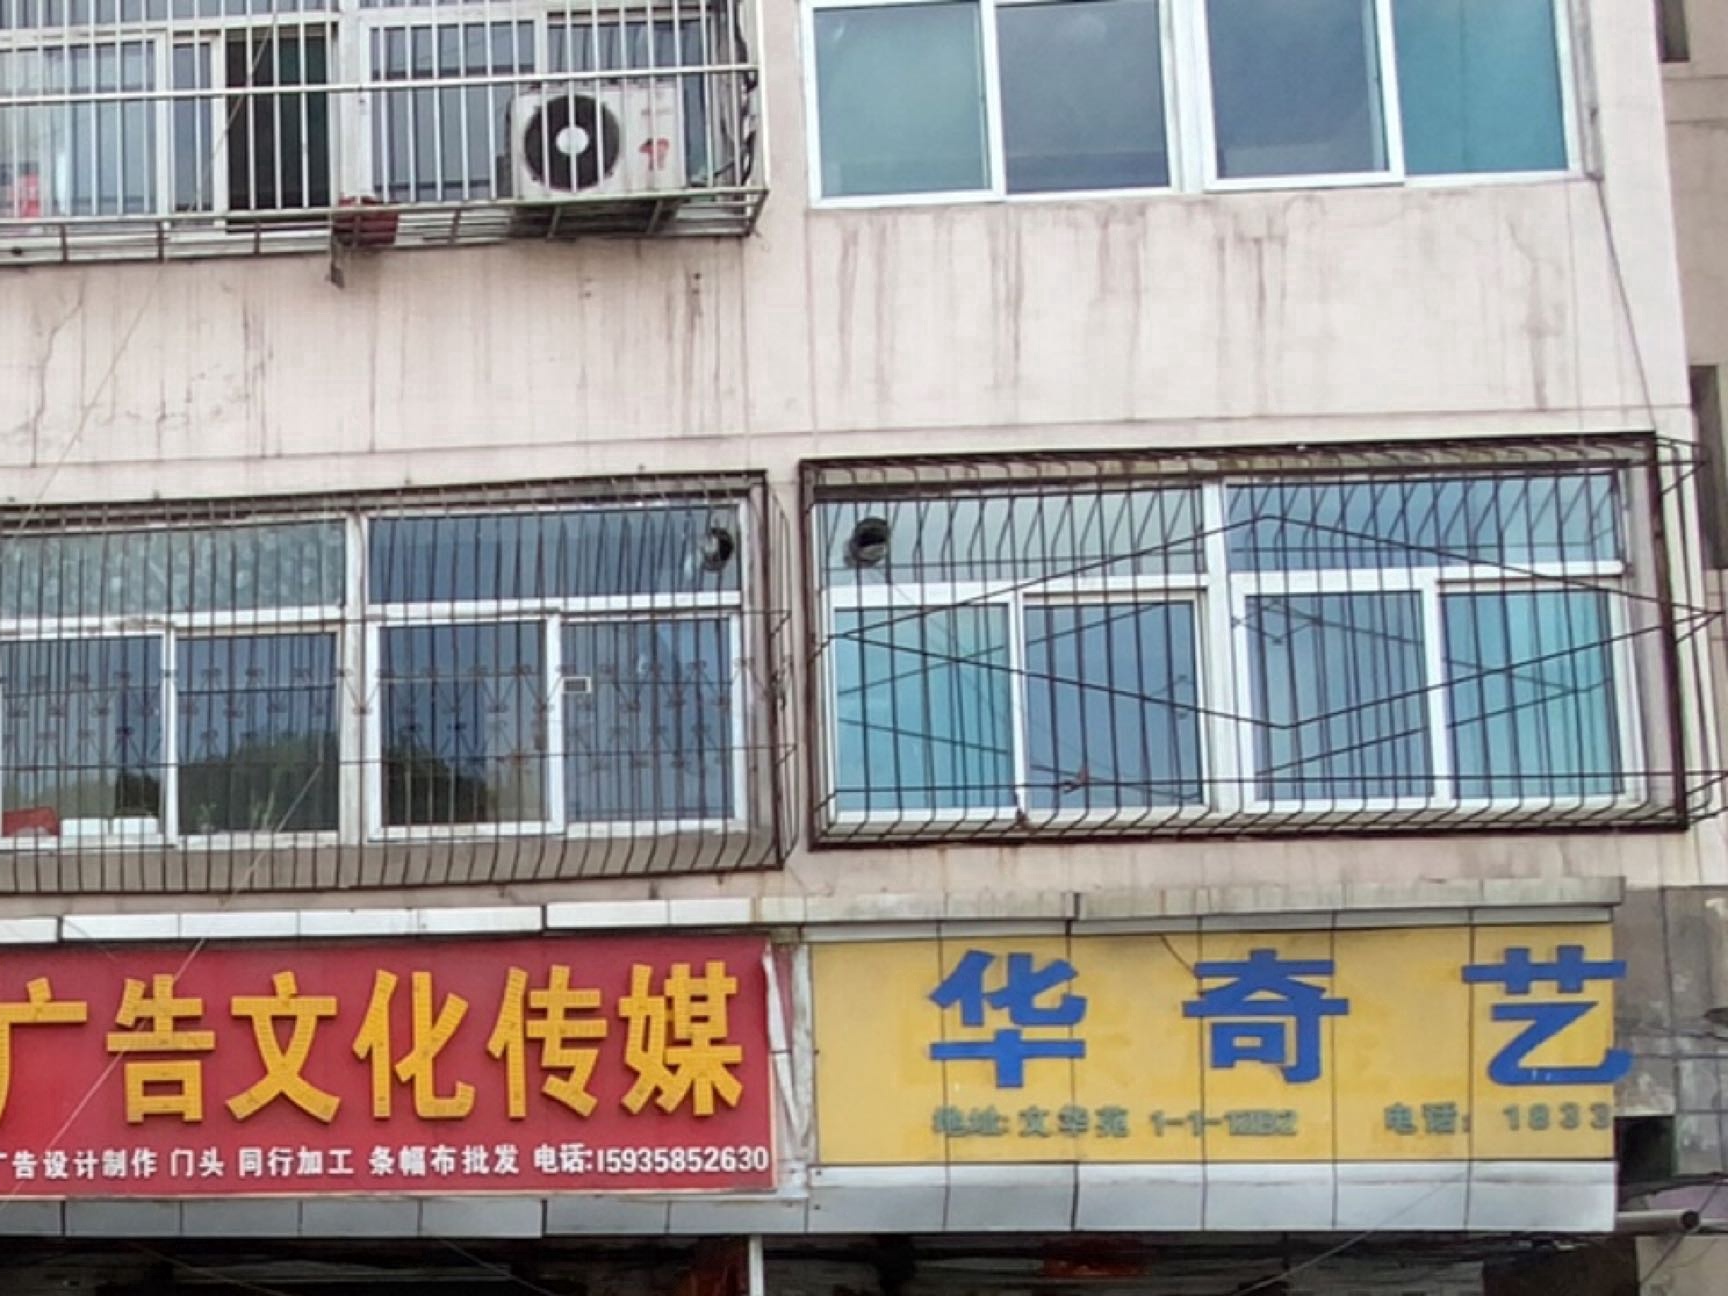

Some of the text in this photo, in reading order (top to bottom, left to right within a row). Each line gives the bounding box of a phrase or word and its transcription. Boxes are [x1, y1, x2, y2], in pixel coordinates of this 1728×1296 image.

[927, 946, 1633, 1089] 华奇艺
[169, 1145, 226, 1178] 门头
